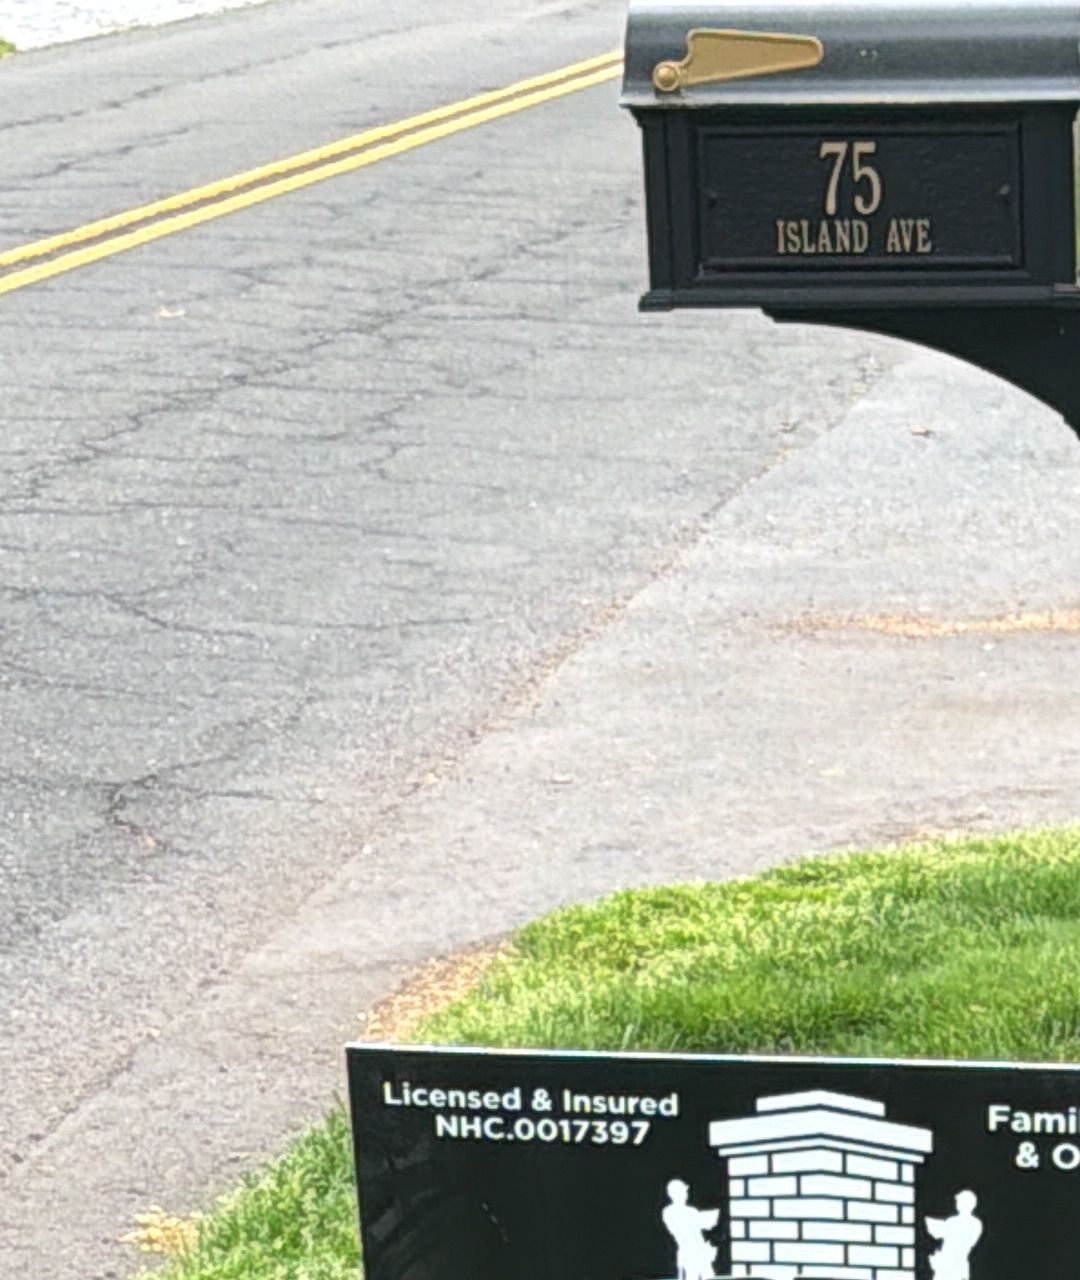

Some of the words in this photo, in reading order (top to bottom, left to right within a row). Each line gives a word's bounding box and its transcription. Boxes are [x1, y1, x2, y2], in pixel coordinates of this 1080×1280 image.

[821, 141, 881, 215] 75
[777, 219, 868, 253] ISLAND
[887, 219, 932, 253] AVE
[383, 1081, 522, 1111] Licensed
[531, 1088, 553, 1112] &
[563, 1089, 679, 1117] Insured
[435, 1114, 650, 1145] NHC.0017397
[1015, 1141, 1040, 1168] &
